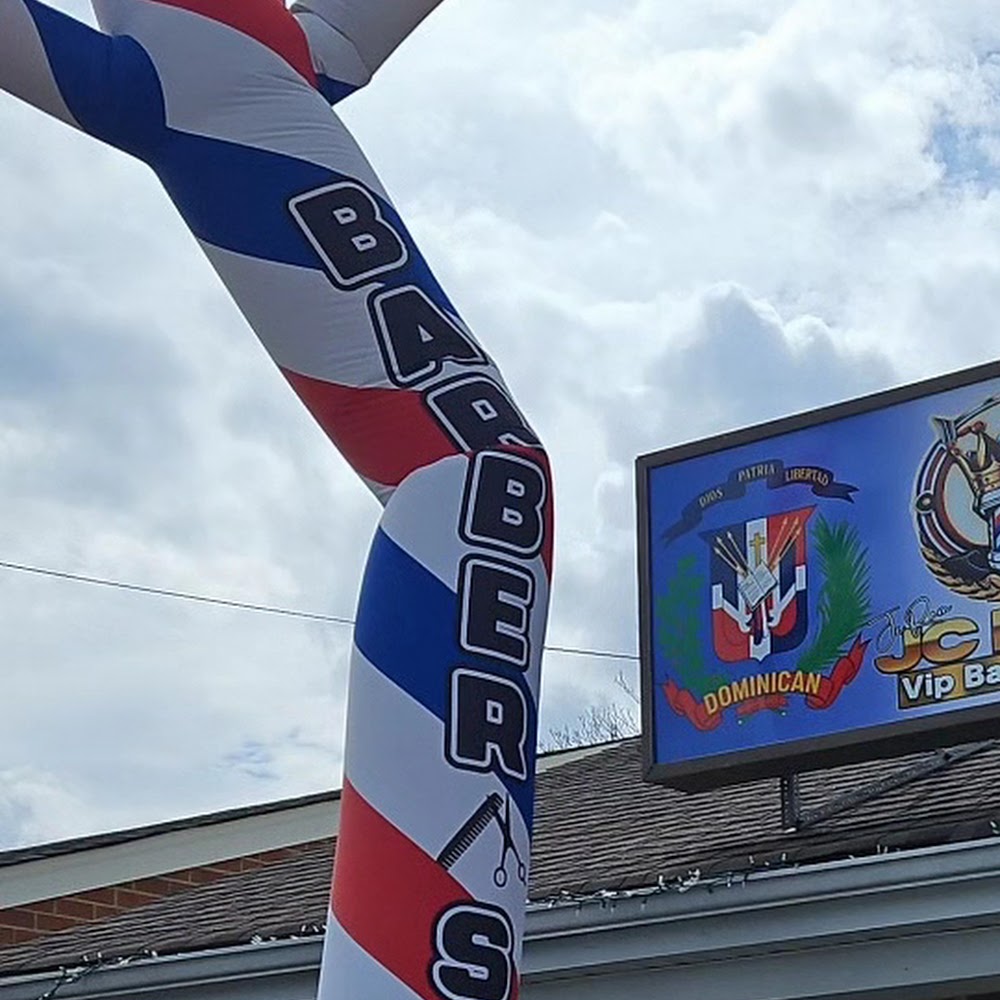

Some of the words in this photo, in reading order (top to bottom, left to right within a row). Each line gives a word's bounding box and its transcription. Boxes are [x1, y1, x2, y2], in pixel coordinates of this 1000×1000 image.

[285, 178, 547, 782] BARBER
[698, 488, 724, 508] DIOS
[737, 463, 777, 483] PATRIA
[785, 466, 830, 487] LIBERTAD
[873, 616, 980, 676] JC
[703, 669, 822, 716] DOMINICAN
[901, 672, 955, 701] Vip
